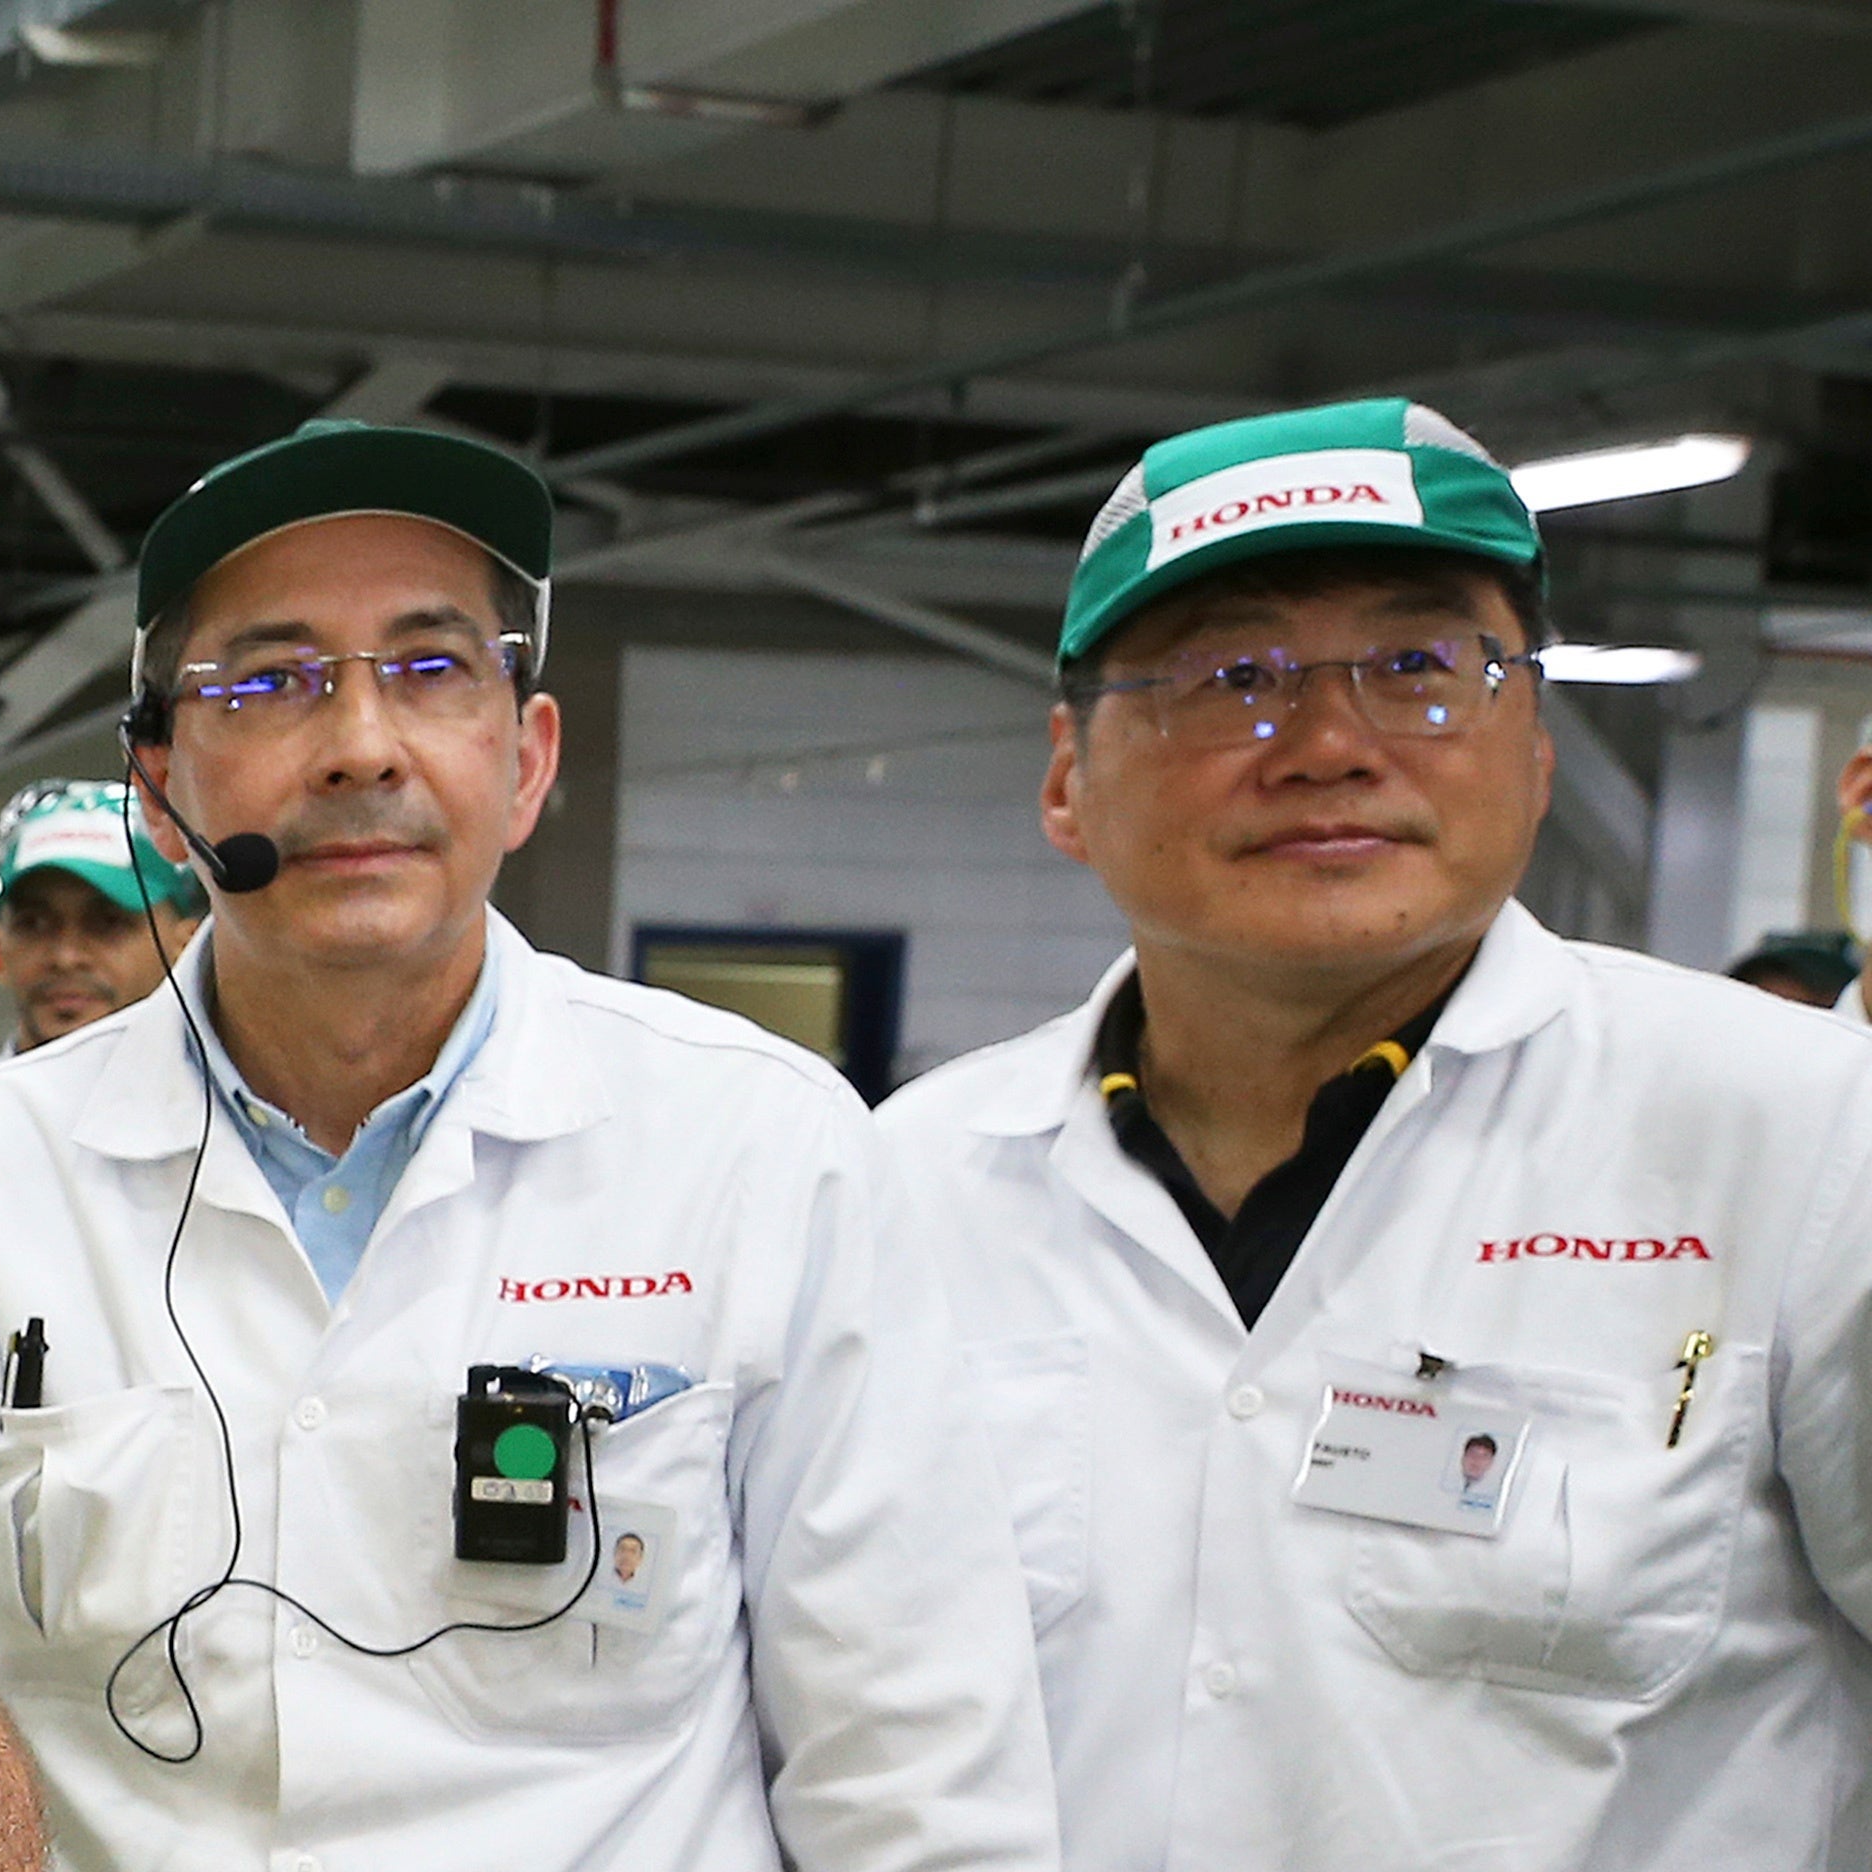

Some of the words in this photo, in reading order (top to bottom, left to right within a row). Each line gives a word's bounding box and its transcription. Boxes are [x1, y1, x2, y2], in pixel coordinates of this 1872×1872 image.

[1170, 483, 1390, 541] HONDA
[1475, 1233, 1713, 1264] HONDA
[499, 1271, 694, 1303] HONDA
[1333, 1389, 1438, 1418] HONDA
